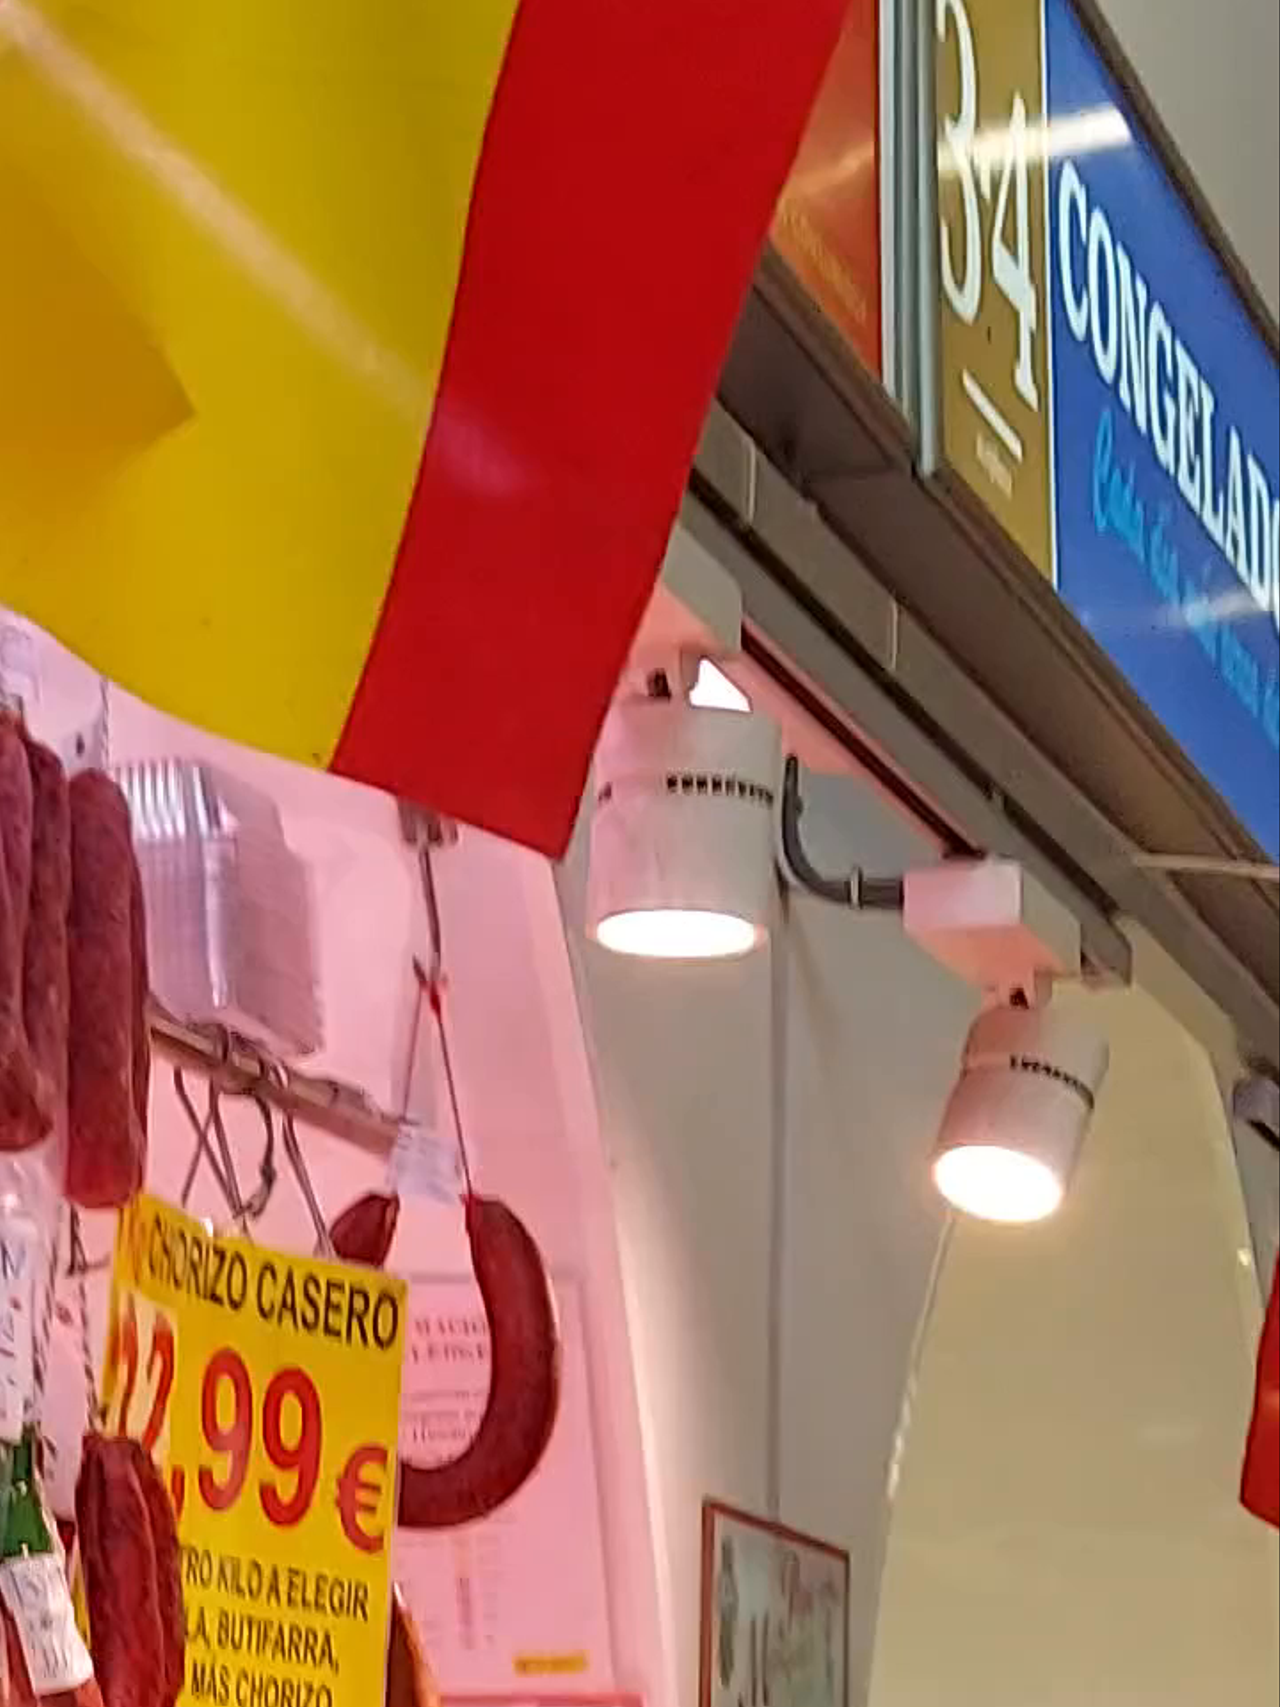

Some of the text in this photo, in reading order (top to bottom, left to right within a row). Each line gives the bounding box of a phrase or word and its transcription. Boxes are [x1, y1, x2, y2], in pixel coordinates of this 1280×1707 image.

[1057, 159, 1280, 633] CONGELAD
[147, 1213, 249, 1312] CHORIZO
[256, 1261, 399, 1351] CASERO
[217, 1554, 263, 1601] KILO
[266, 1563, 281, 1607] A
[287, 1566, 369, 1623] ELEGIR
